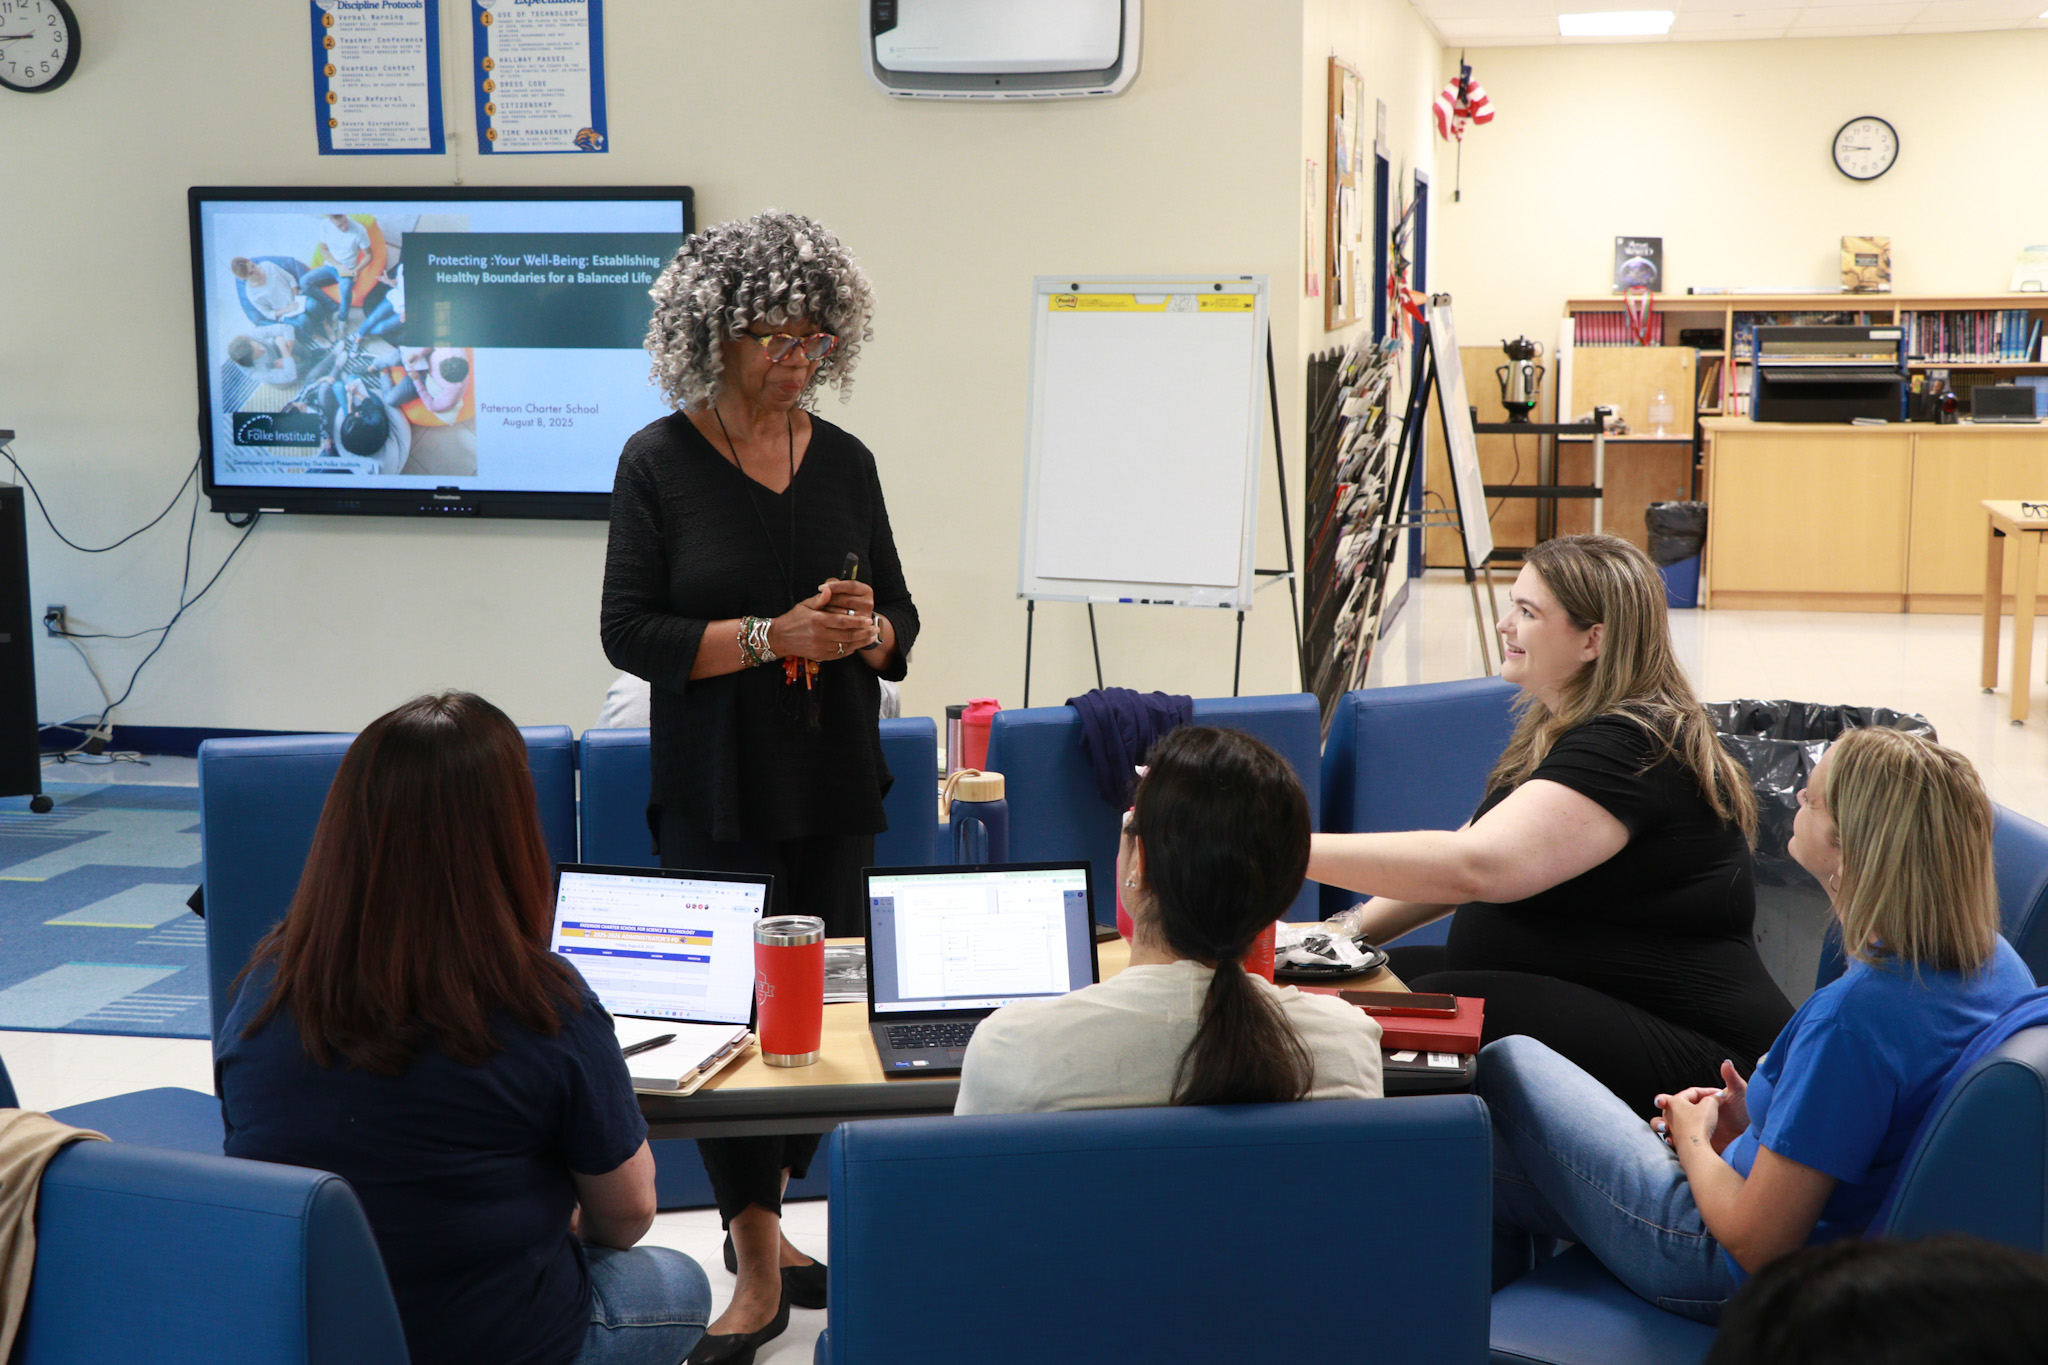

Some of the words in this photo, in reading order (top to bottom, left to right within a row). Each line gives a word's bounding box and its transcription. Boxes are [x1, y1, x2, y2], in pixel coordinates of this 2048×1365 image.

[2, 2, 12, 13] 11
[36, 2, 41, 13] 1
[337, 0, 380, 11] Discipline
[382, 0, 423, 9] Protocols
[47, 14, 56, 26] 2
[53, 31, 62, 42] 3
[51, 48, 60, 60] 4
[8, 61, 16, 73] 7
[25, 66, 35, 78] 6
[41, 61, 50, 73] 5
[428, 254, 488, 269] Protecting
[490, 254, 520, 266] :Your
[523, 254, 589, 269] Well-Being:
[592, 254, 660, 268] Establishing
[436, 272, 480, 285] Healthy
[482, 272, 546, 284] Boundaries
[548, 272, 566, 283] for
[568, 275, 574, 283] a
[577, 272, 629, 284] Balanced
[632, 272, 652, 284] Life
[481, 403, 522, 413] Paterson
[525, 403, 562, 414] Charter
[566, 404, 599, 414] School
[502, 418, 534, 429] August
[537, 418, 546, 428] 8,
[549, 418, 573, 427] 2025
[248, 430, 274, 440] Folke
[275, 431, 316, 441] Institute
